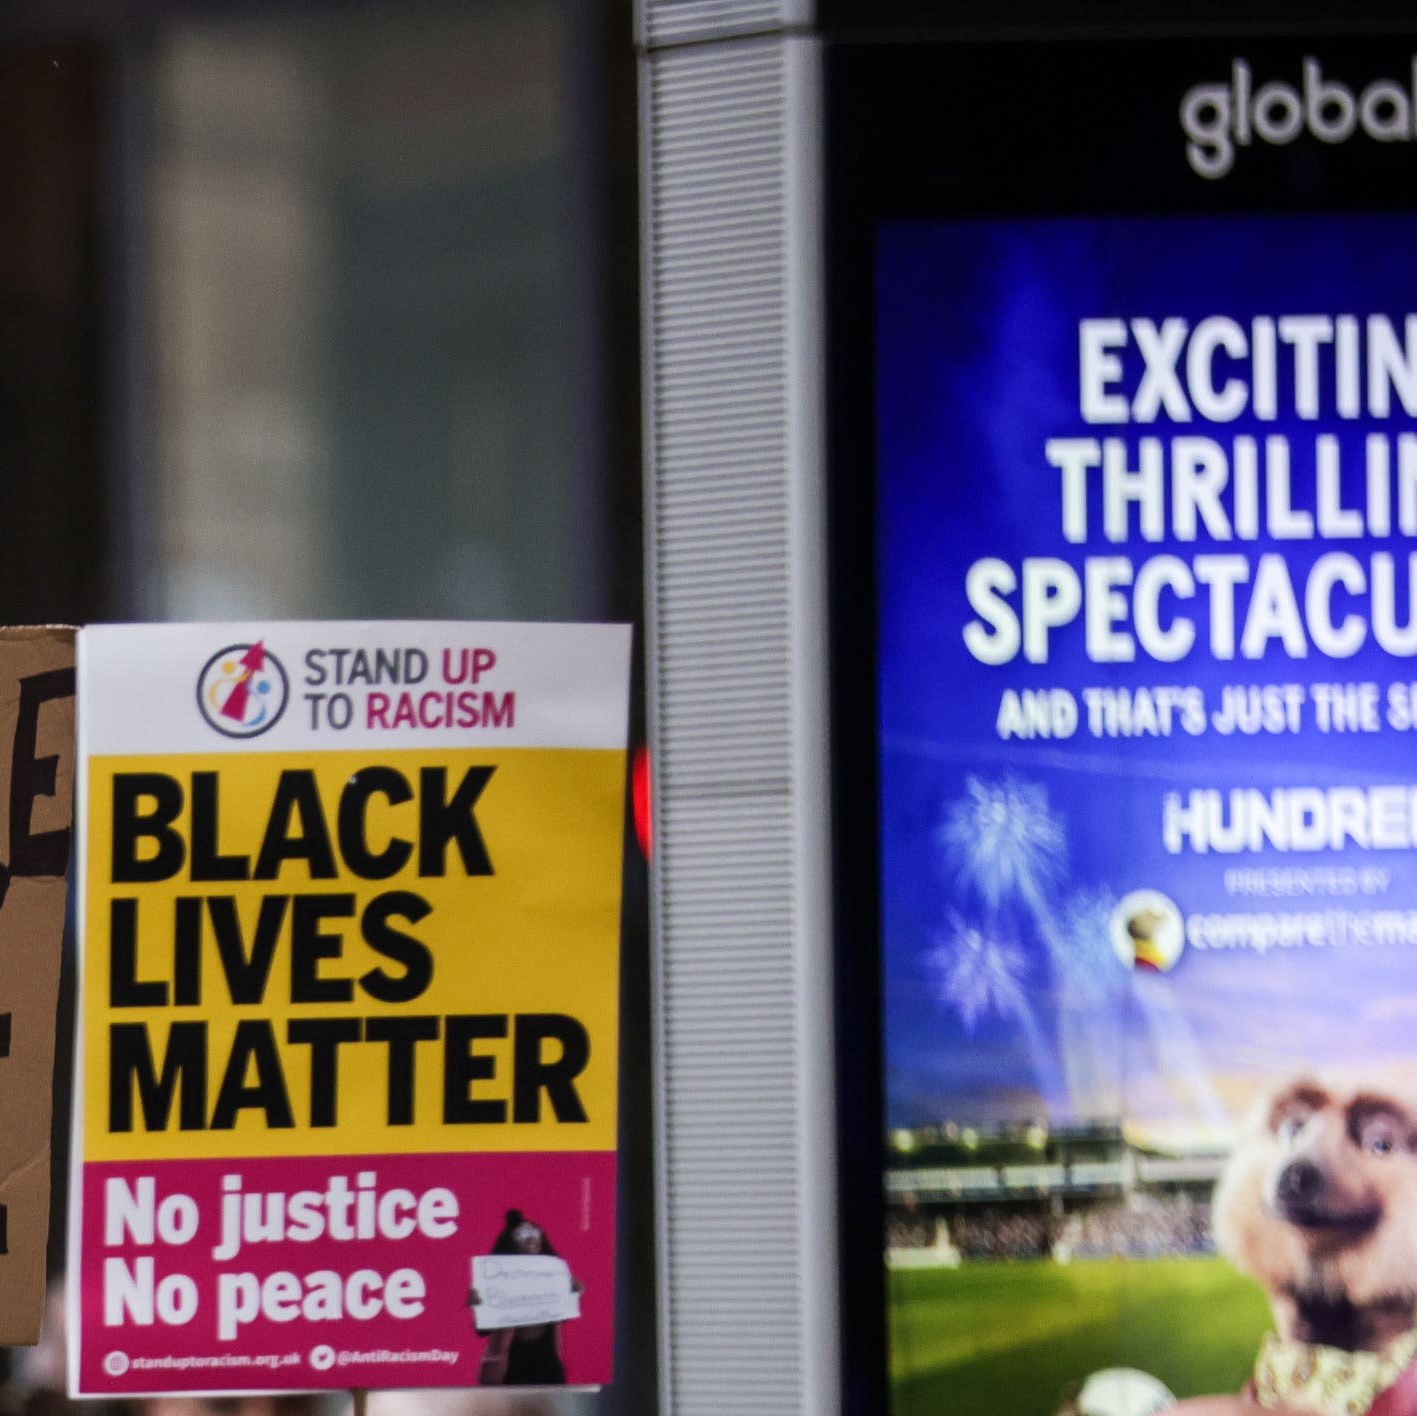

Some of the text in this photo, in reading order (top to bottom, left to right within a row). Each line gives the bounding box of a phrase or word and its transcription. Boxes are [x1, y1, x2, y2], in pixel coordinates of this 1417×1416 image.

[963, 552, 1417, 666] SPECTACU
[304, 648, 497, 685] STAND UP
[303, 690, 515, 730] TO RACISM
[997, 687, 1078, 740] AND
[1082, 685, 1207, 737] THAT'S
[1212, 683, 1305, 736] JUST
[1311, 682, 1380, 734] THE
[110, 765, 497, 883] BLACK
[1164, 784, 1417, 854] HUNDRE
[109, 890, 435, 1007] LIVES
[108, 1013, 590, 1133] MATTER
[104, 1171, 460, 1261] No justice
[104, 1256, 426, 1341] No peace
[132, 1349, 459, 1369] standuptoracism.org.uk @AntiRacismDay
